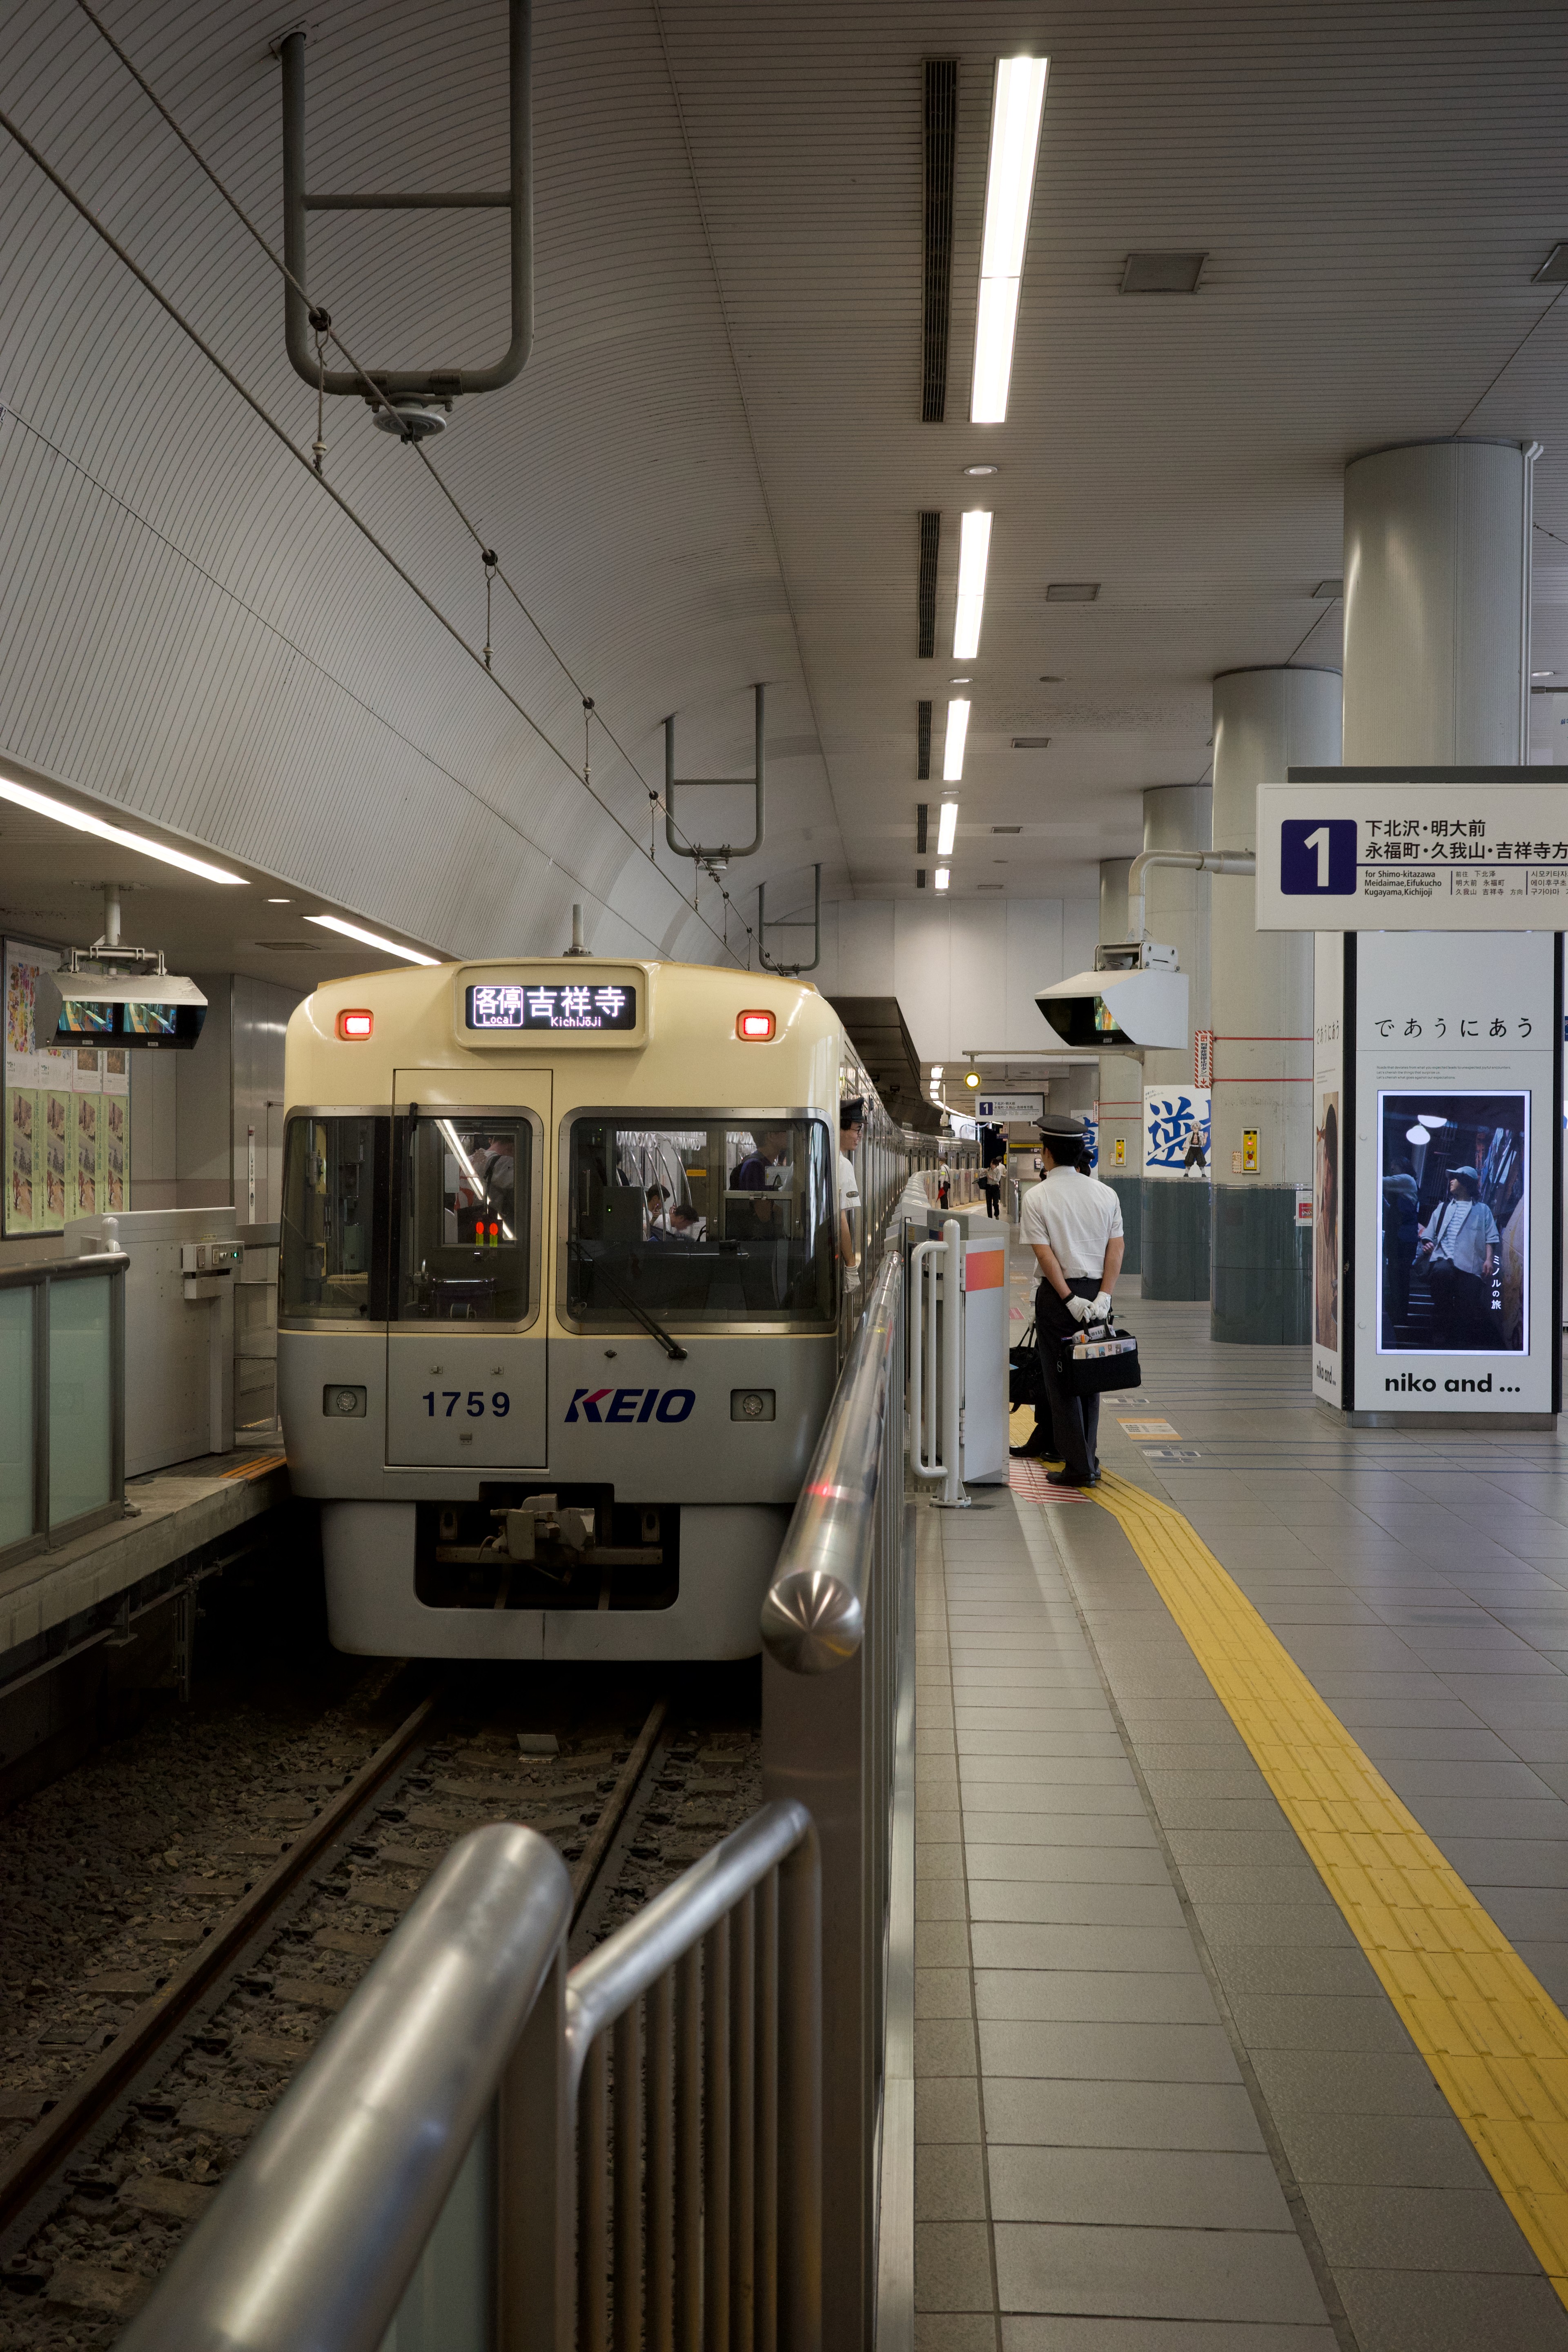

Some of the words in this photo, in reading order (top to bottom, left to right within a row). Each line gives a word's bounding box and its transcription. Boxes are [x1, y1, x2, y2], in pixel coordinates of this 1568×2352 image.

[1365, 819, 1486, 837] 下北沢・明大前
[1303, 827, 1330, 887] 1
[1365, 841, 1568, 860] 永福町・久我山・吉祥寺方
[1365, 879, 1442, 887] Meidaimae,Eifukucho
[1365, 888, 1432, 897] Kugayama,Kichijoji
[476, 988, 521, 1014] 各停
[526, 986, 626, 1017] 吉祥寺
[483, 1014, 513, 1025] Local
[1374, 1018, 1532, 1038] であうにあう
[983, 1103, 989, 1114] 1
[1491, 1255, 1501, 1310] ミノルの旅
[1385, 1373, 1437, 1392] niko
[1444, 1373, 1492, 1392] and
[422, 1391, 510, 1417] 1759
[564, 1388, 696, 1423] KEIO
